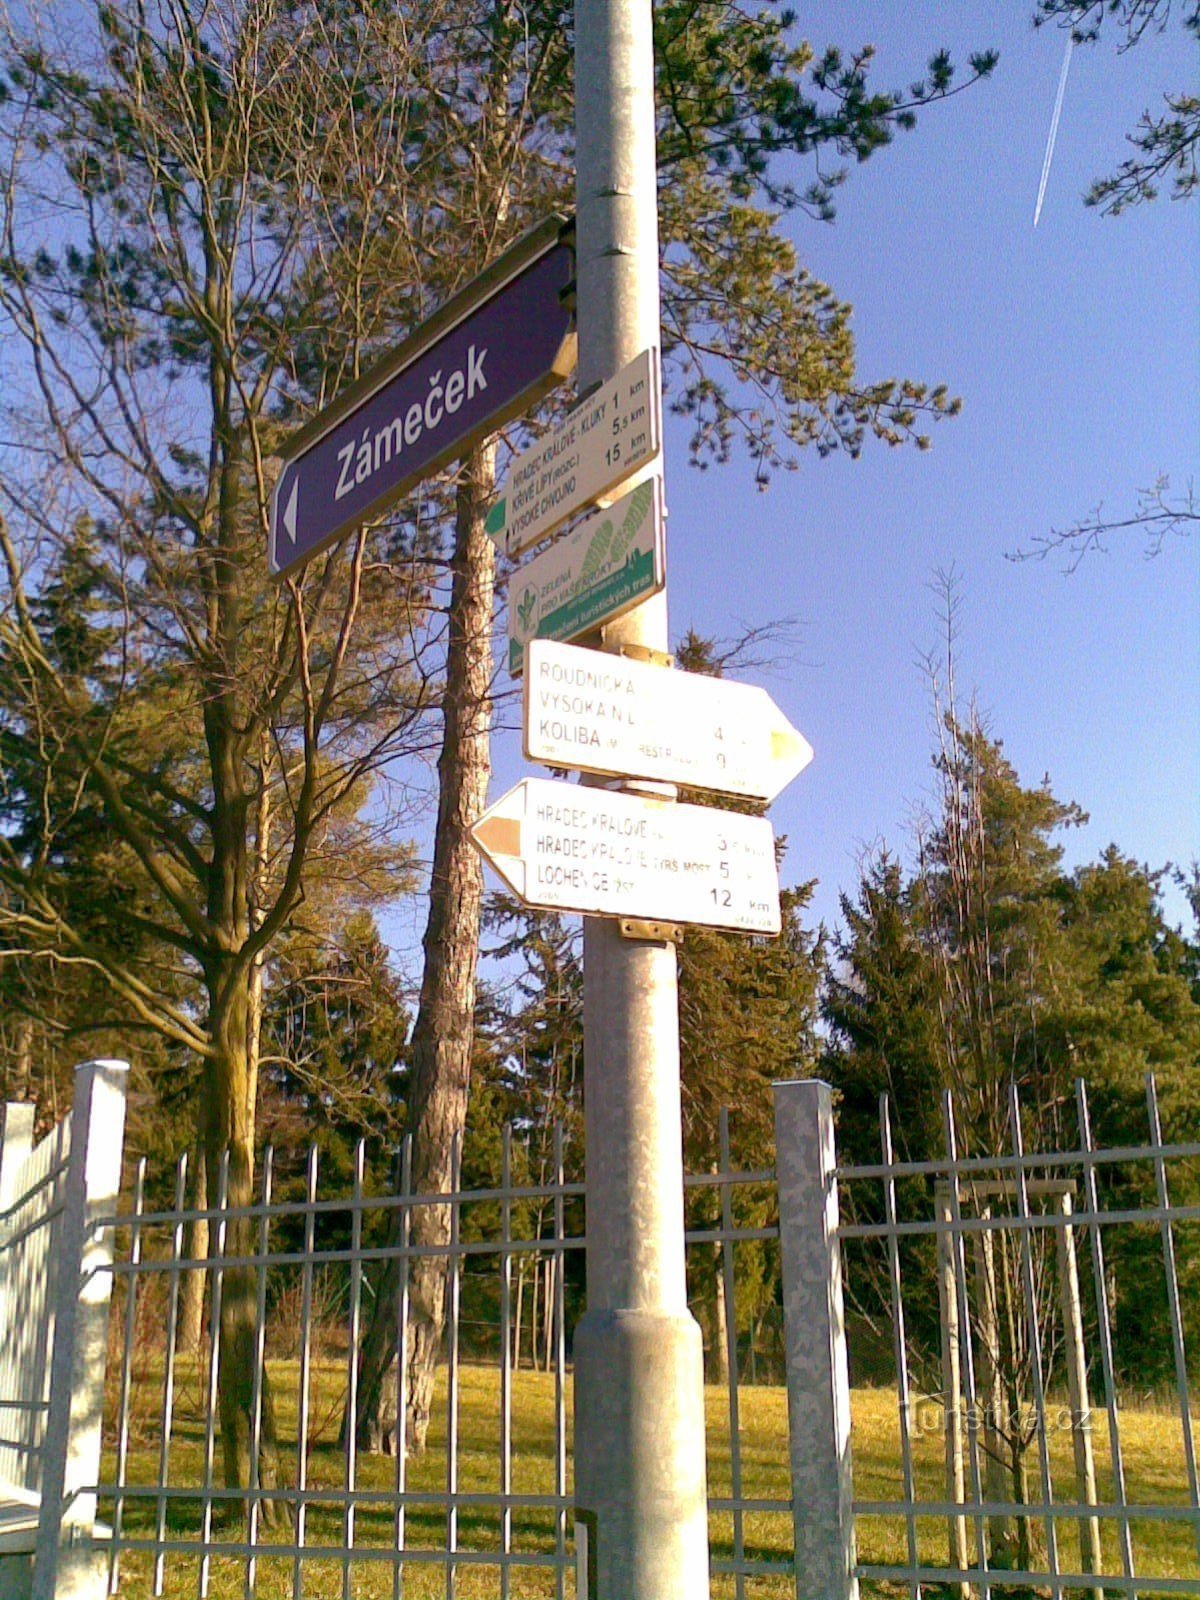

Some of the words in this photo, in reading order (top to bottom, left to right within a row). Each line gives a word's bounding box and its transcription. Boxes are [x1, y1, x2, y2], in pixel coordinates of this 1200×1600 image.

[335, 344, 488, 500] Zámeček
[631, 405, 645, 422] km
[514, 455, 541, 489] HRADEC
[613, 391, 619, 410] 1
[630, 380, 645, 397] km
[605, 441, 621, 466] 15
[631, 432, 646, 449] km
[540, 719, 601, 747] KOLIBA
[719, 861, 730, 879] 5
[537, 863, 609, 892] LOCHENCE
[710, 887, 732, 908] 12
[749, 899, 770, 913] km
